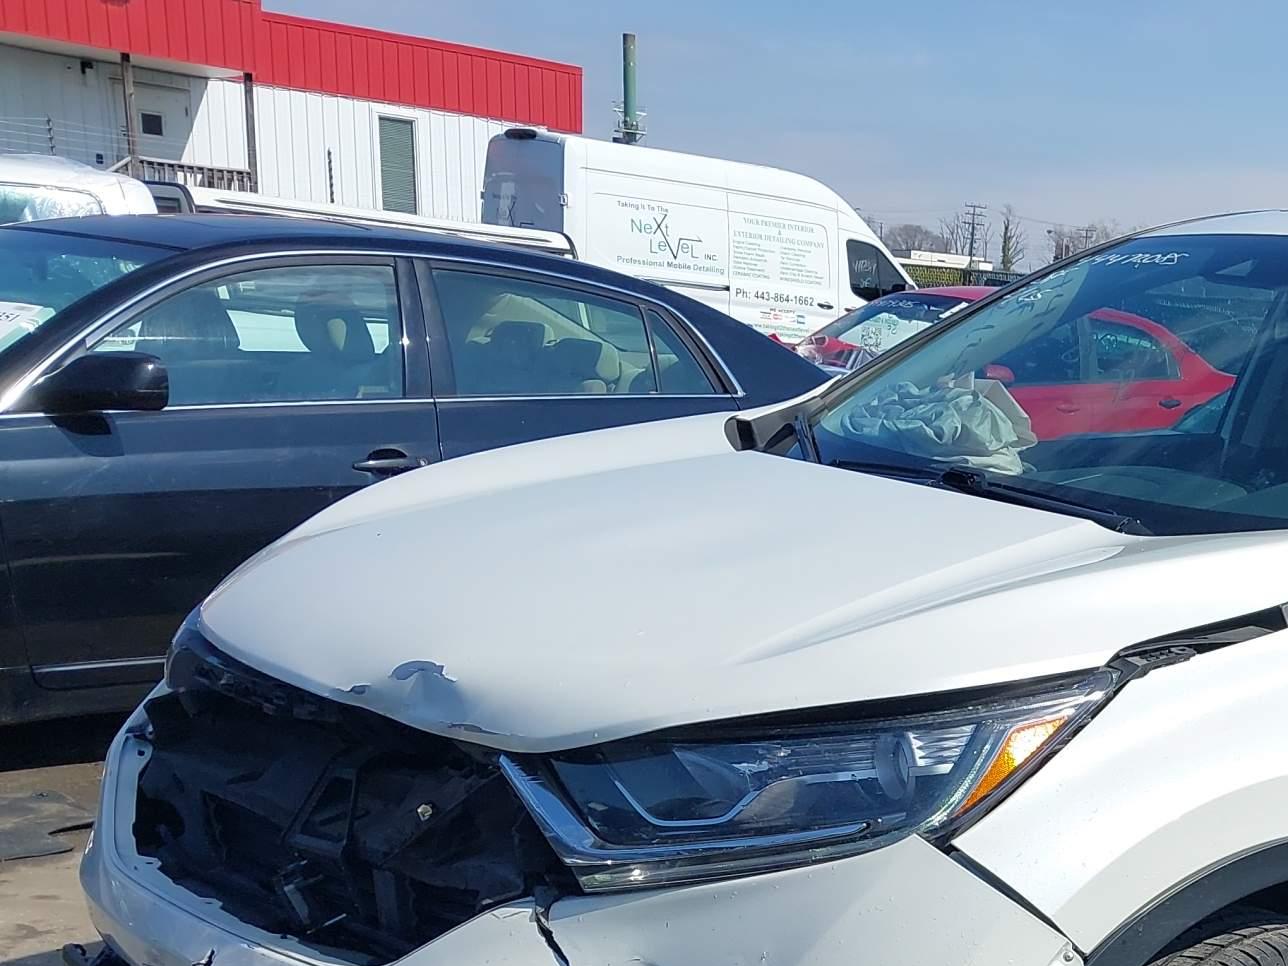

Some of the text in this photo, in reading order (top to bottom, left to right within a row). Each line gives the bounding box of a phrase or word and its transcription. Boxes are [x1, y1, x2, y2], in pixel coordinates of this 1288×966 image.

[616, 255, 665, 268] Professional
[666, 261, 692, 270] Mobile
[692, 264, 725, 275] Detailing
[735, 287, 814, 306] Ph: 443-864-1662
